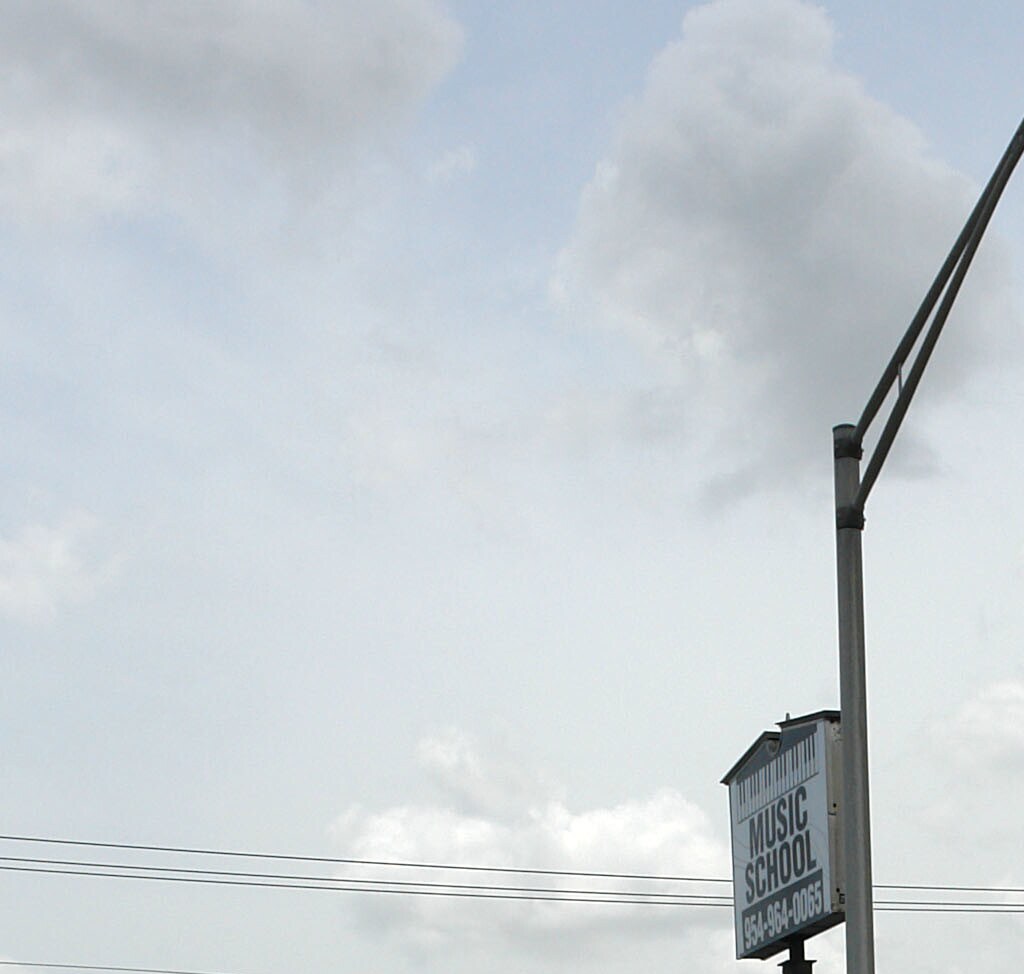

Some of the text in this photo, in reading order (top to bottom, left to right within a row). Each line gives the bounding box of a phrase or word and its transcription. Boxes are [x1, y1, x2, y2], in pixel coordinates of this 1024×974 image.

[750, 785, 808, 859] MUSIC
[745, 830, 817, 905] SCHOOL
[744, 880, 822, 950] 954-964-0065
